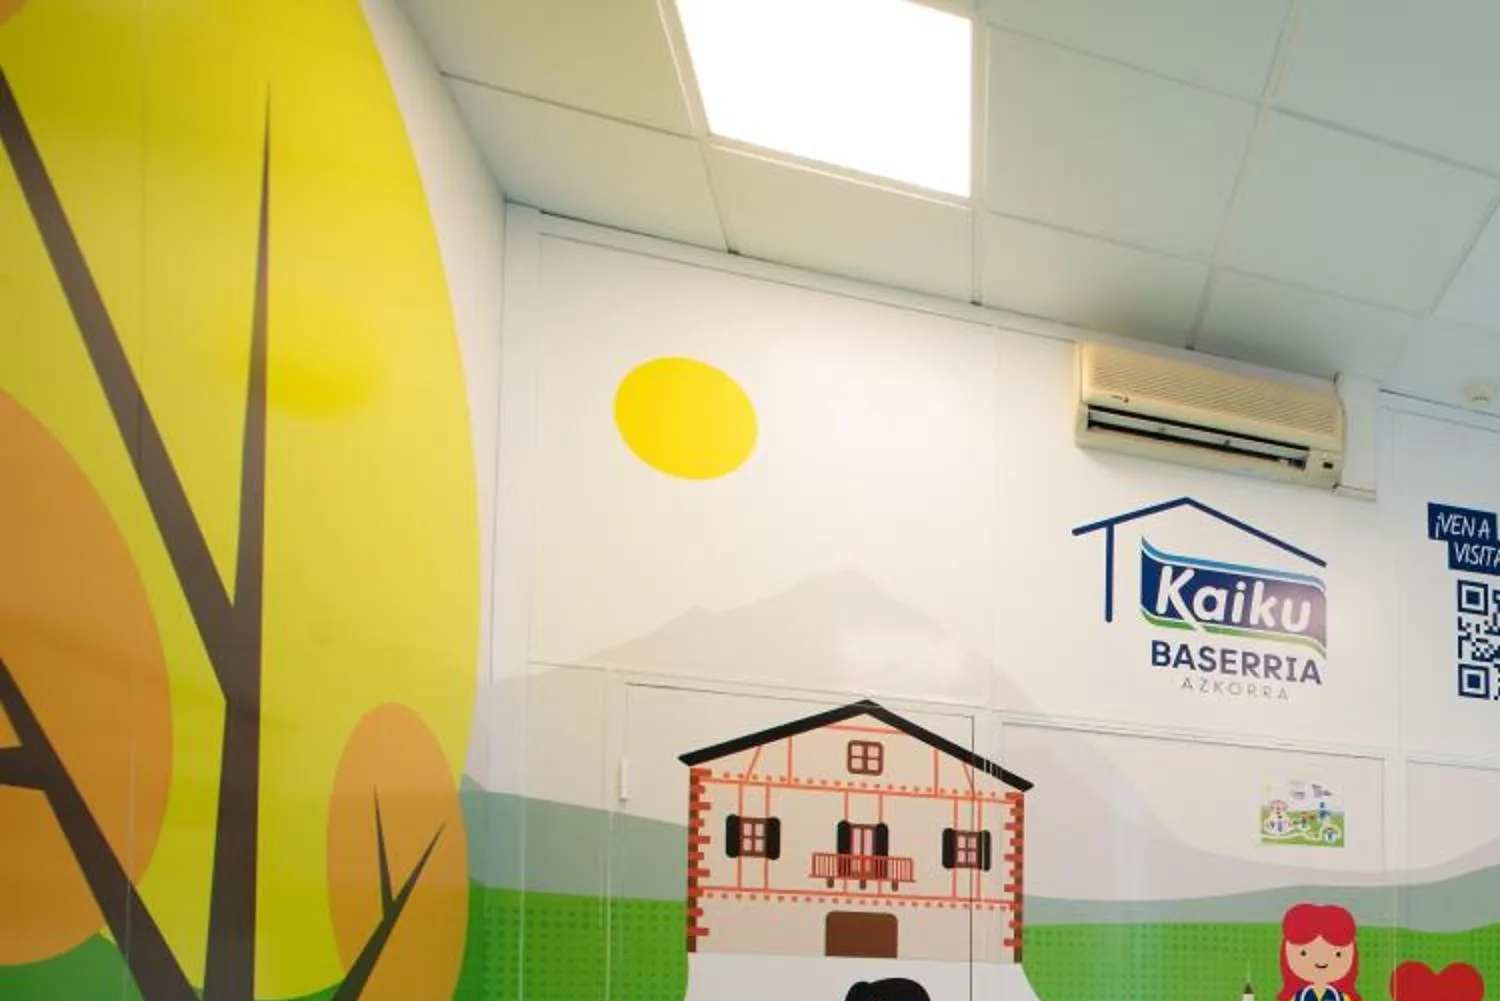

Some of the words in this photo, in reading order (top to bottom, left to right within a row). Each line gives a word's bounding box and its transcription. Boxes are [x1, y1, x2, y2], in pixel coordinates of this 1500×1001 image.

[1435, 512, 1476, 539] ¡VEN
[1478, 517, 1491, 540] A
[1155, 565, 1311, 633] Kaiku
[1151, 639, 1323, 685] BASERRIA
[1181, 676, 1290, 700] AZKORRA
